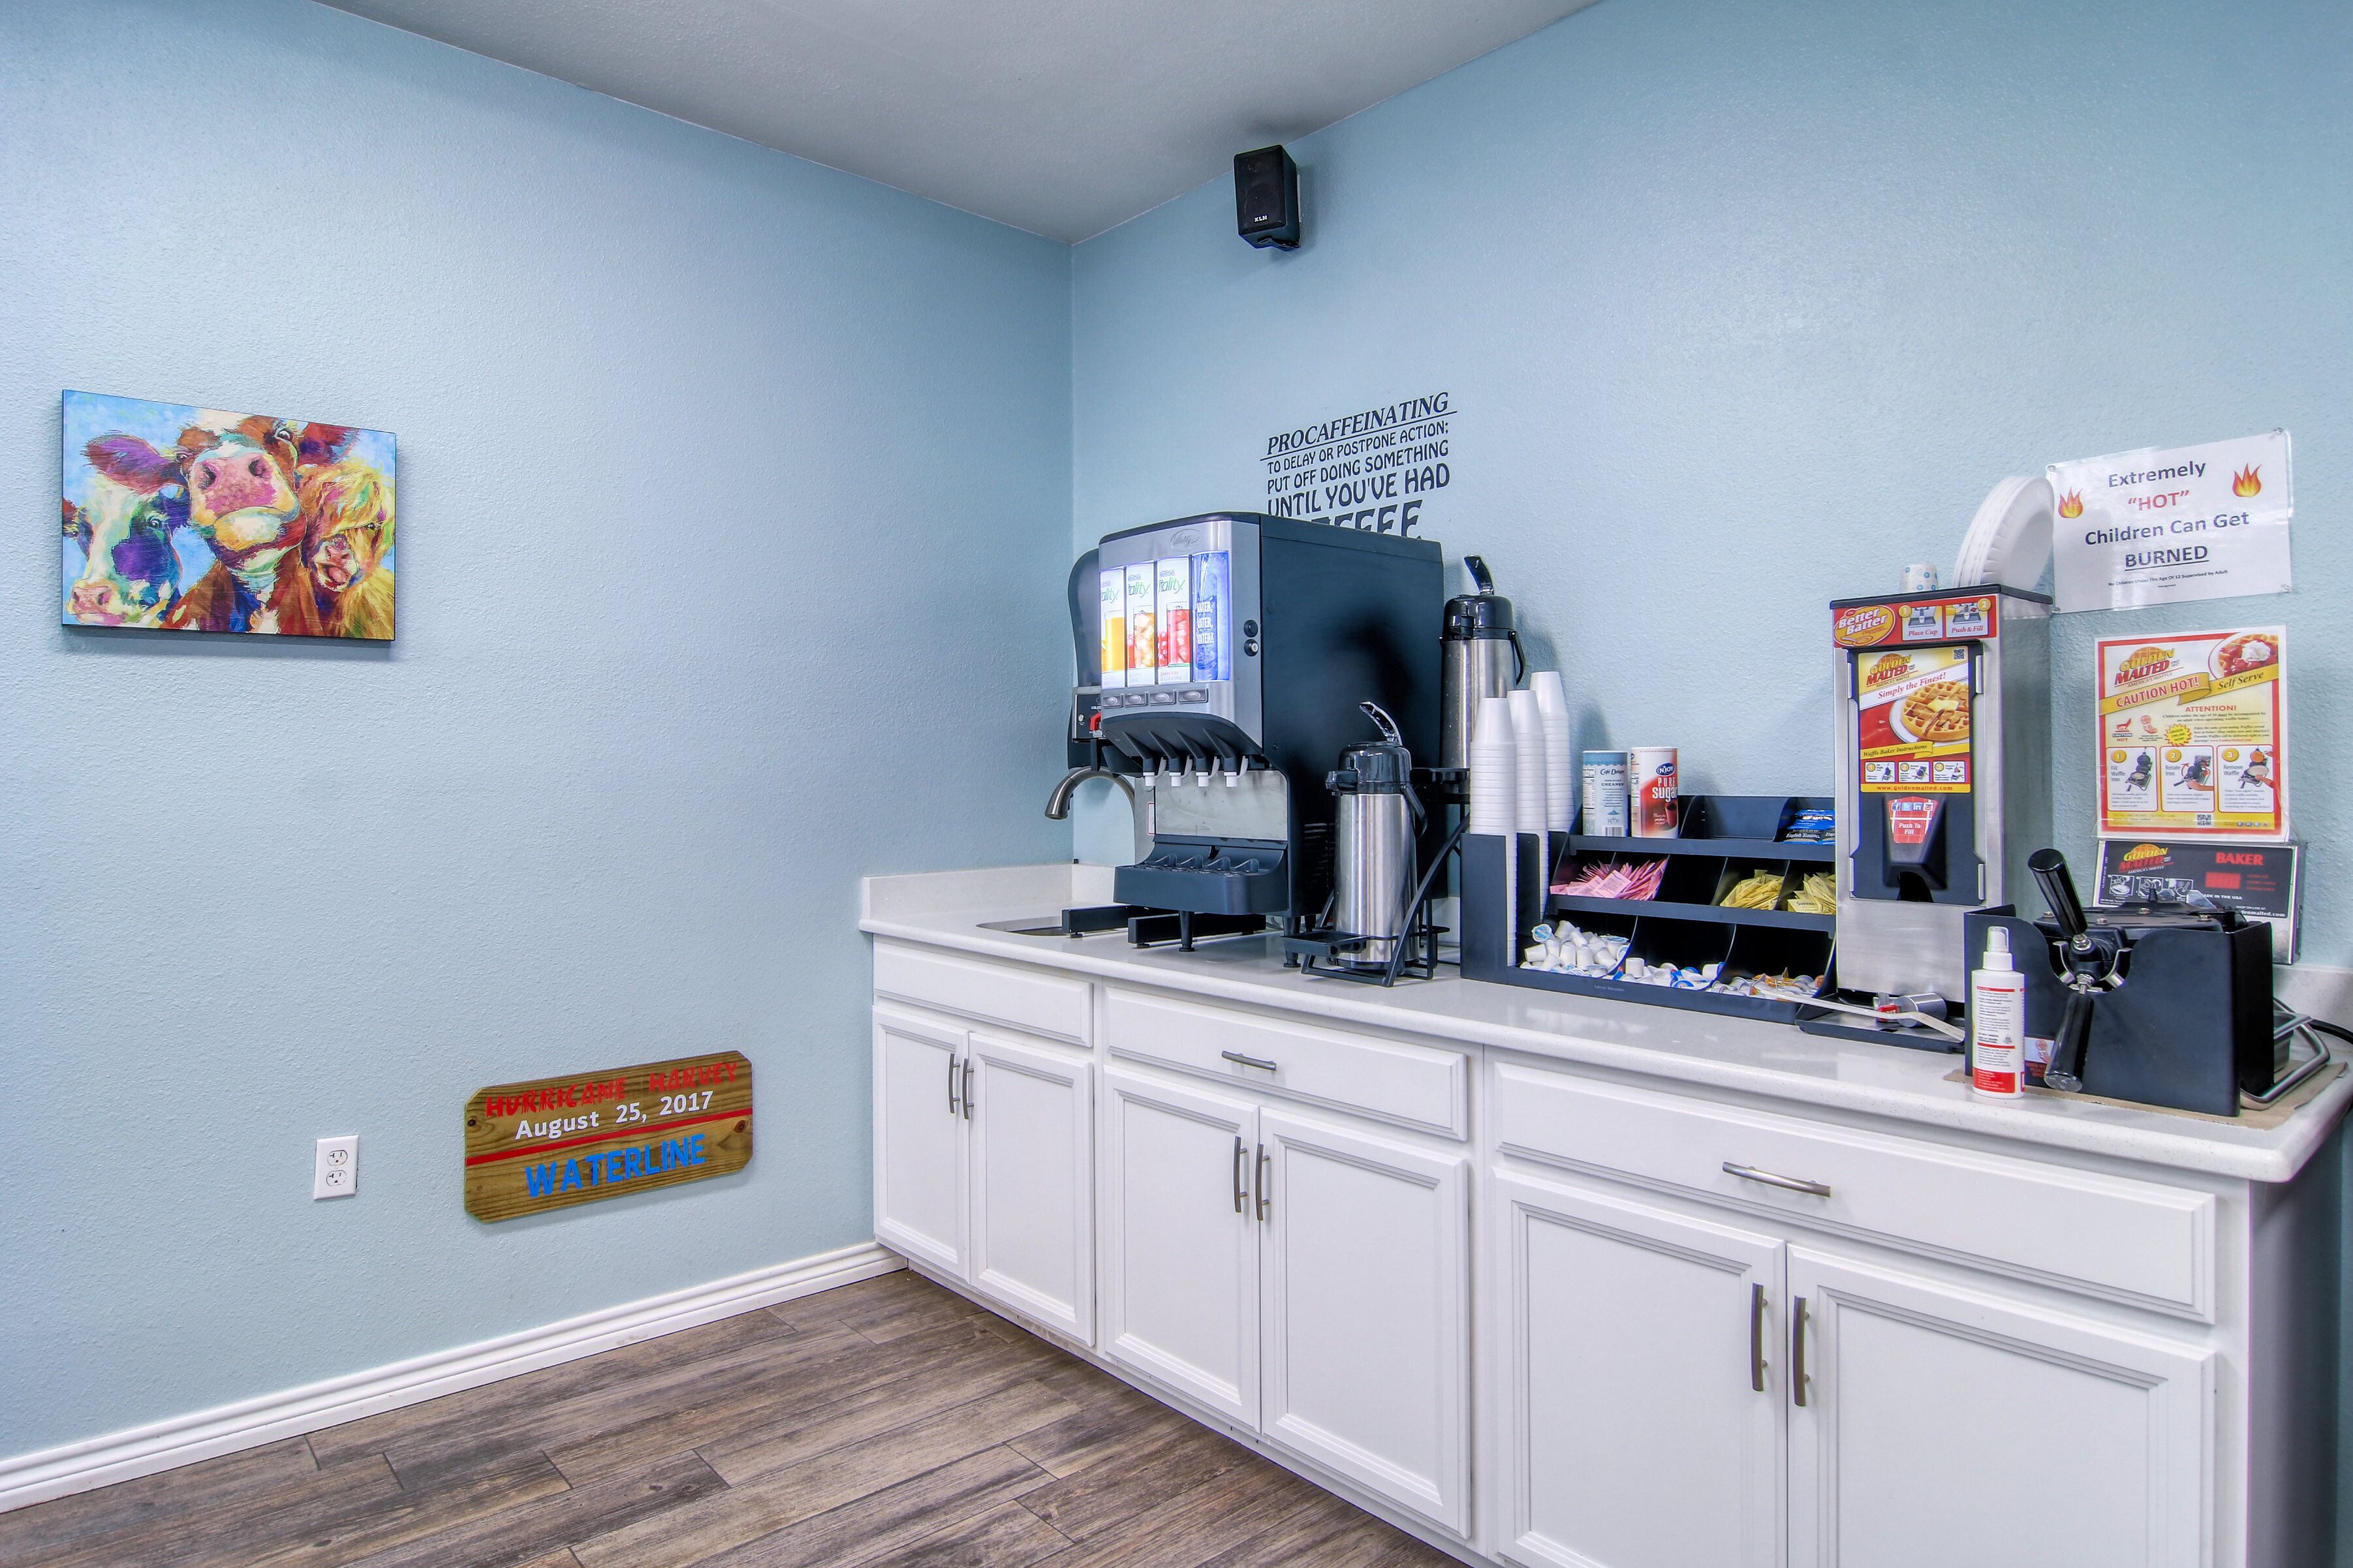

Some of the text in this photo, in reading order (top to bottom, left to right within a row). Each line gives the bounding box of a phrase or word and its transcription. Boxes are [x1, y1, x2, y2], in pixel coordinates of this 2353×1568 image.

[1267, 392, 1449, 455] PROCAFFEINATING
[1268, 421, 1449, 474] TO DELAY OR POSTPONE ACTION;
[1268, 440, 1449, 495] PUT OFF DOING SOMETHING
[2108, 461, 2206, 488] Extremely
[1268, 463, 1450, 517] UNTIL YOU'VE HAD
[2085, 512, 2250, 546] Children Can Get
[2125, 546, 2209, 568] BURNED
[1839, 607, 1880, 629] Better
[1846, 614, 1888, 636] Batter
[1870, 654, 1912, 675] GOLDEN
[2119, 647, 2175, 672] GOLDEN
[1867, 664, 1908, 685] MALTED
[2115, 660, 2170, 685] MALTED
[2217, 671, 2264, 690] Self Serve
[1878, 672, 1946, 699] Simply the Finest!
[2116, 677, 2200, 707] CAUTION HOT!
[1652, 786, 1677, 803] sugar
[1658, 777, 1675, 787] PURE
[2123, 847, 2168, 861] GOLDEN
[2216, 852, 2264, 866] BAKER
[485, 1062, 738, 1117] HURRICANE HARVEY
[515, 1090, 714, 1140] August 25, 2017
[525, 1133, 706, 1198] WATERLINE
